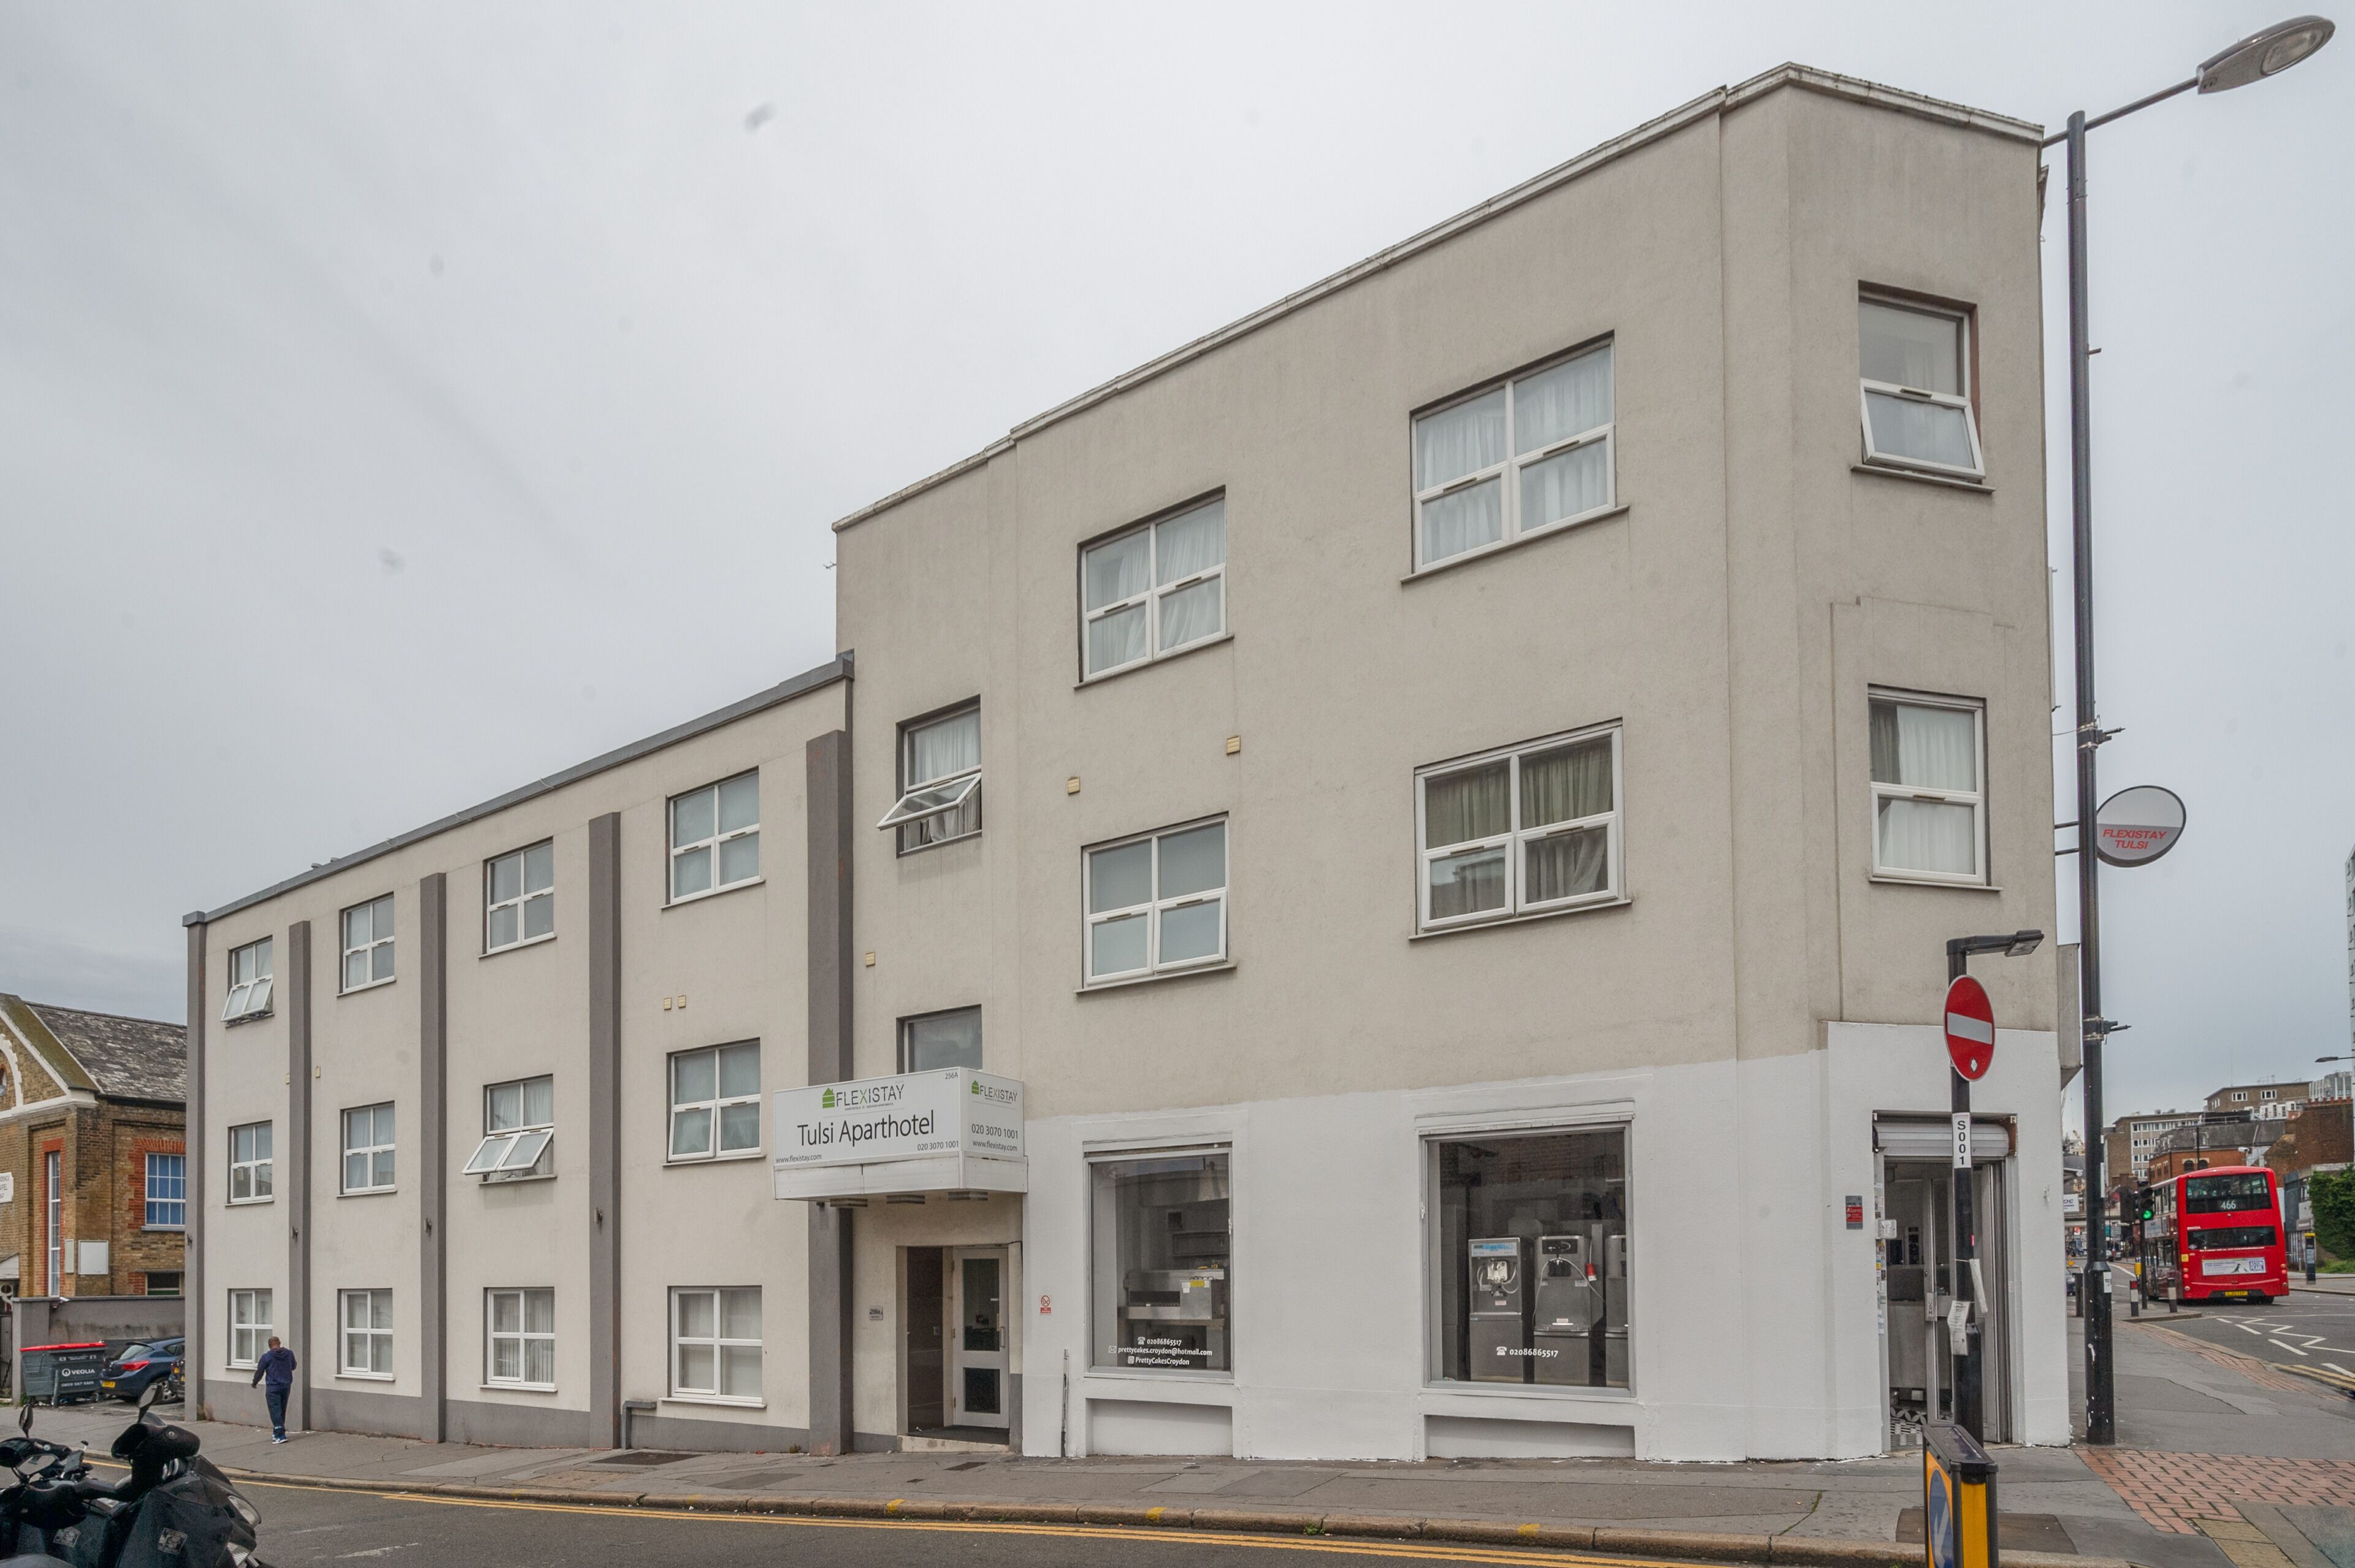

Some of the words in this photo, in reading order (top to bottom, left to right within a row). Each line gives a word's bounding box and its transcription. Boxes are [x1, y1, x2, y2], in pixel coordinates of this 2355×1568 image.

[2102, 829, 2167, 839] FLEXISTAY
[2115, 840, 2149, 849] TULSI
[837, 1084, 905, 1107] FLEXISTAY
[979, 1085, 1018, 1102] FLEXISTAY
[797, 1122, 833, 1146] Tulsi
[838, 1109, 933, 1147] Aparthotel
[971, 1123, 984, 1134] 020
[986, 1125, 1001, 1137] 3070
[1003, 1128, 1018, 1139] 1001
[929, 1141, 944, 1150] 3070
[945, 1140, 959, 1149] 1001
[973, 1140, 1017, 1152] www.flexistay.com
[1957, 1120, 1966, 1165] S001
[775, 1153, 822, 1163] www.flexistay.com
[2221, 1200, 2236, 1210] 466
[1147, 1338, 1182, 1347] 02086865517
[1118, 1347, 1212, 1356] prettycakes.croydon@hotmail.com
[1509, 1348, 1558, 1358] 02086865517
[1135, 1356, 1190, 1366] PrettyCakesCroydon
